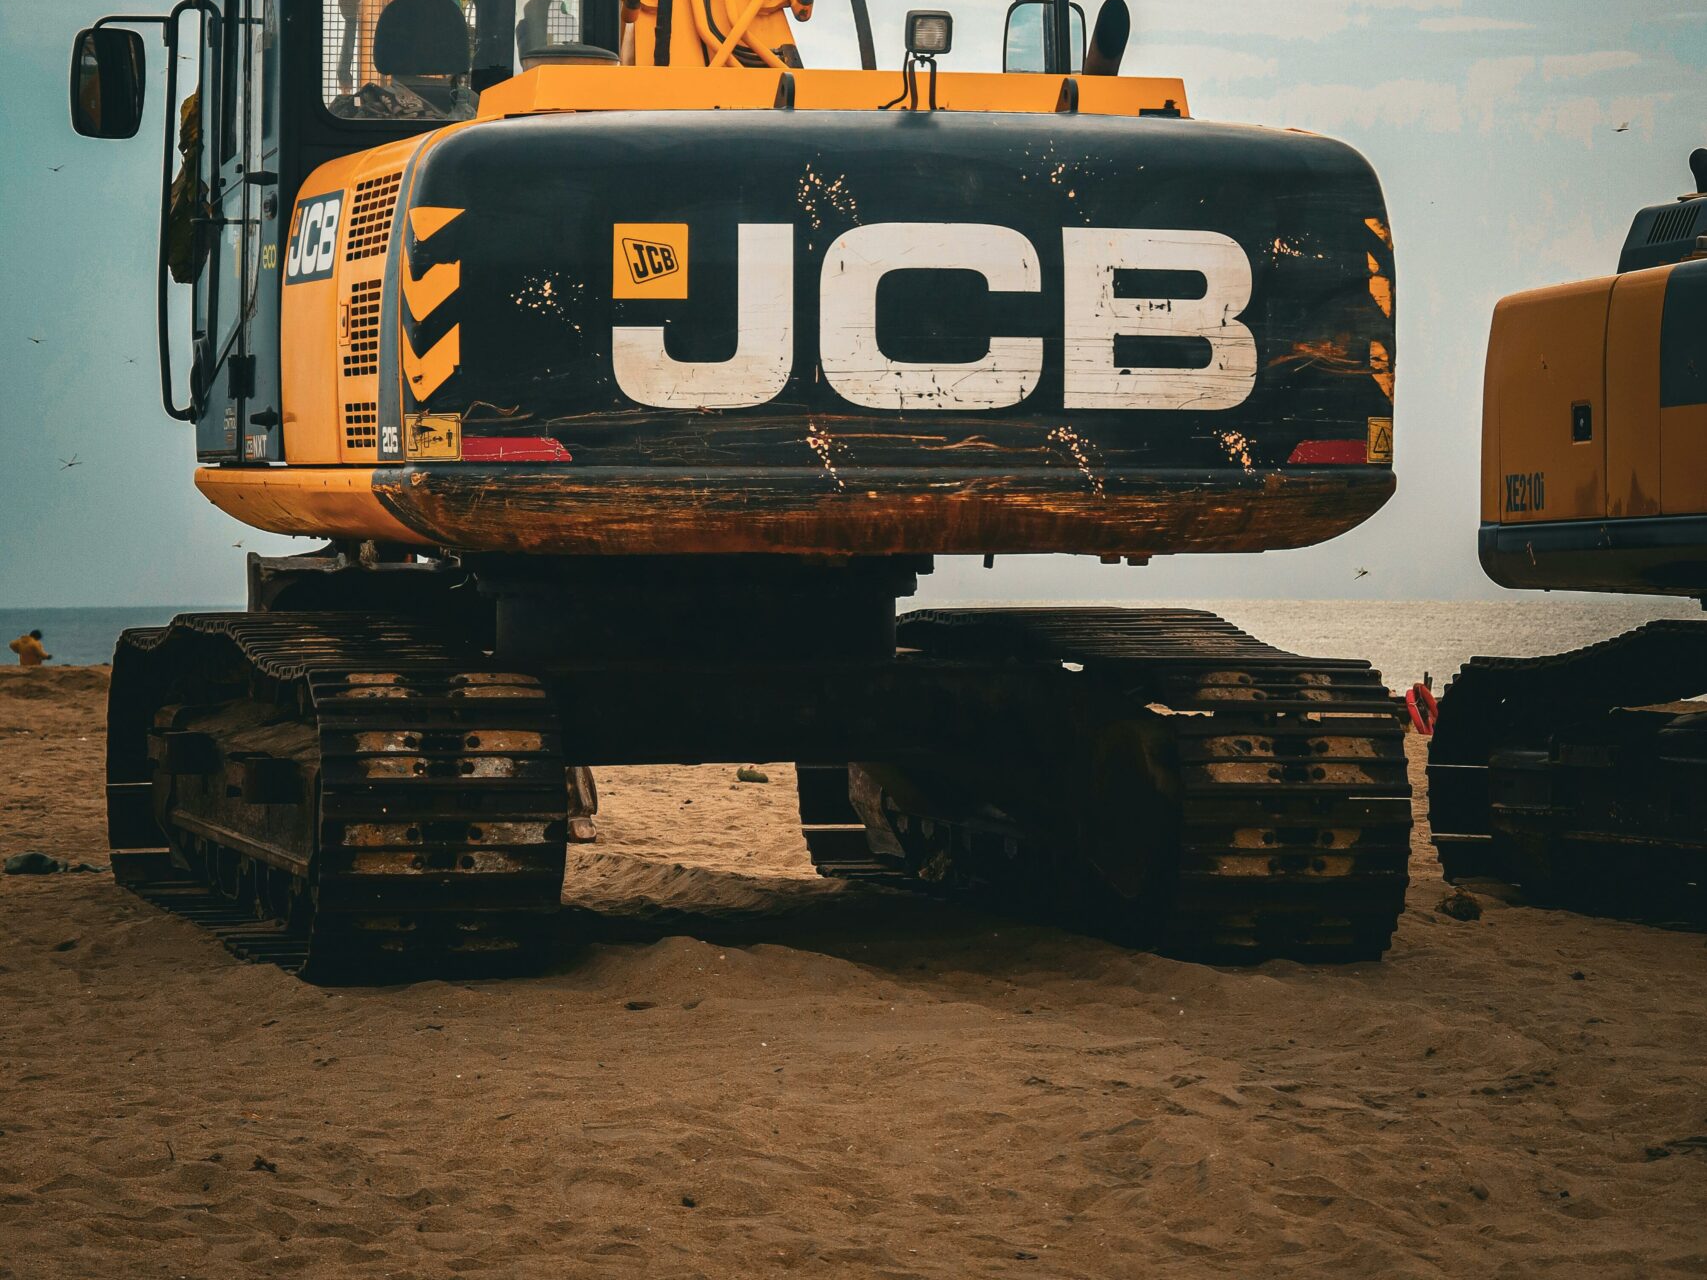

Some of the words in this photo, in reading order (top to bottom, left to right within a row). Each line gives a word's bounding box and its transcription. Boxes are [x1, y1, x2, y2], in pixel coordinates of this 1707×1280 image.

[262, 243, 277, 270] eco
[287, 199, 340, 277] JCB
[632, 243, 675, 278] JCB
[612, 222, 1258, 410] JCB
[382, 426, 399, 453] 205
[1505, 471, 1545, 513] XE210i
